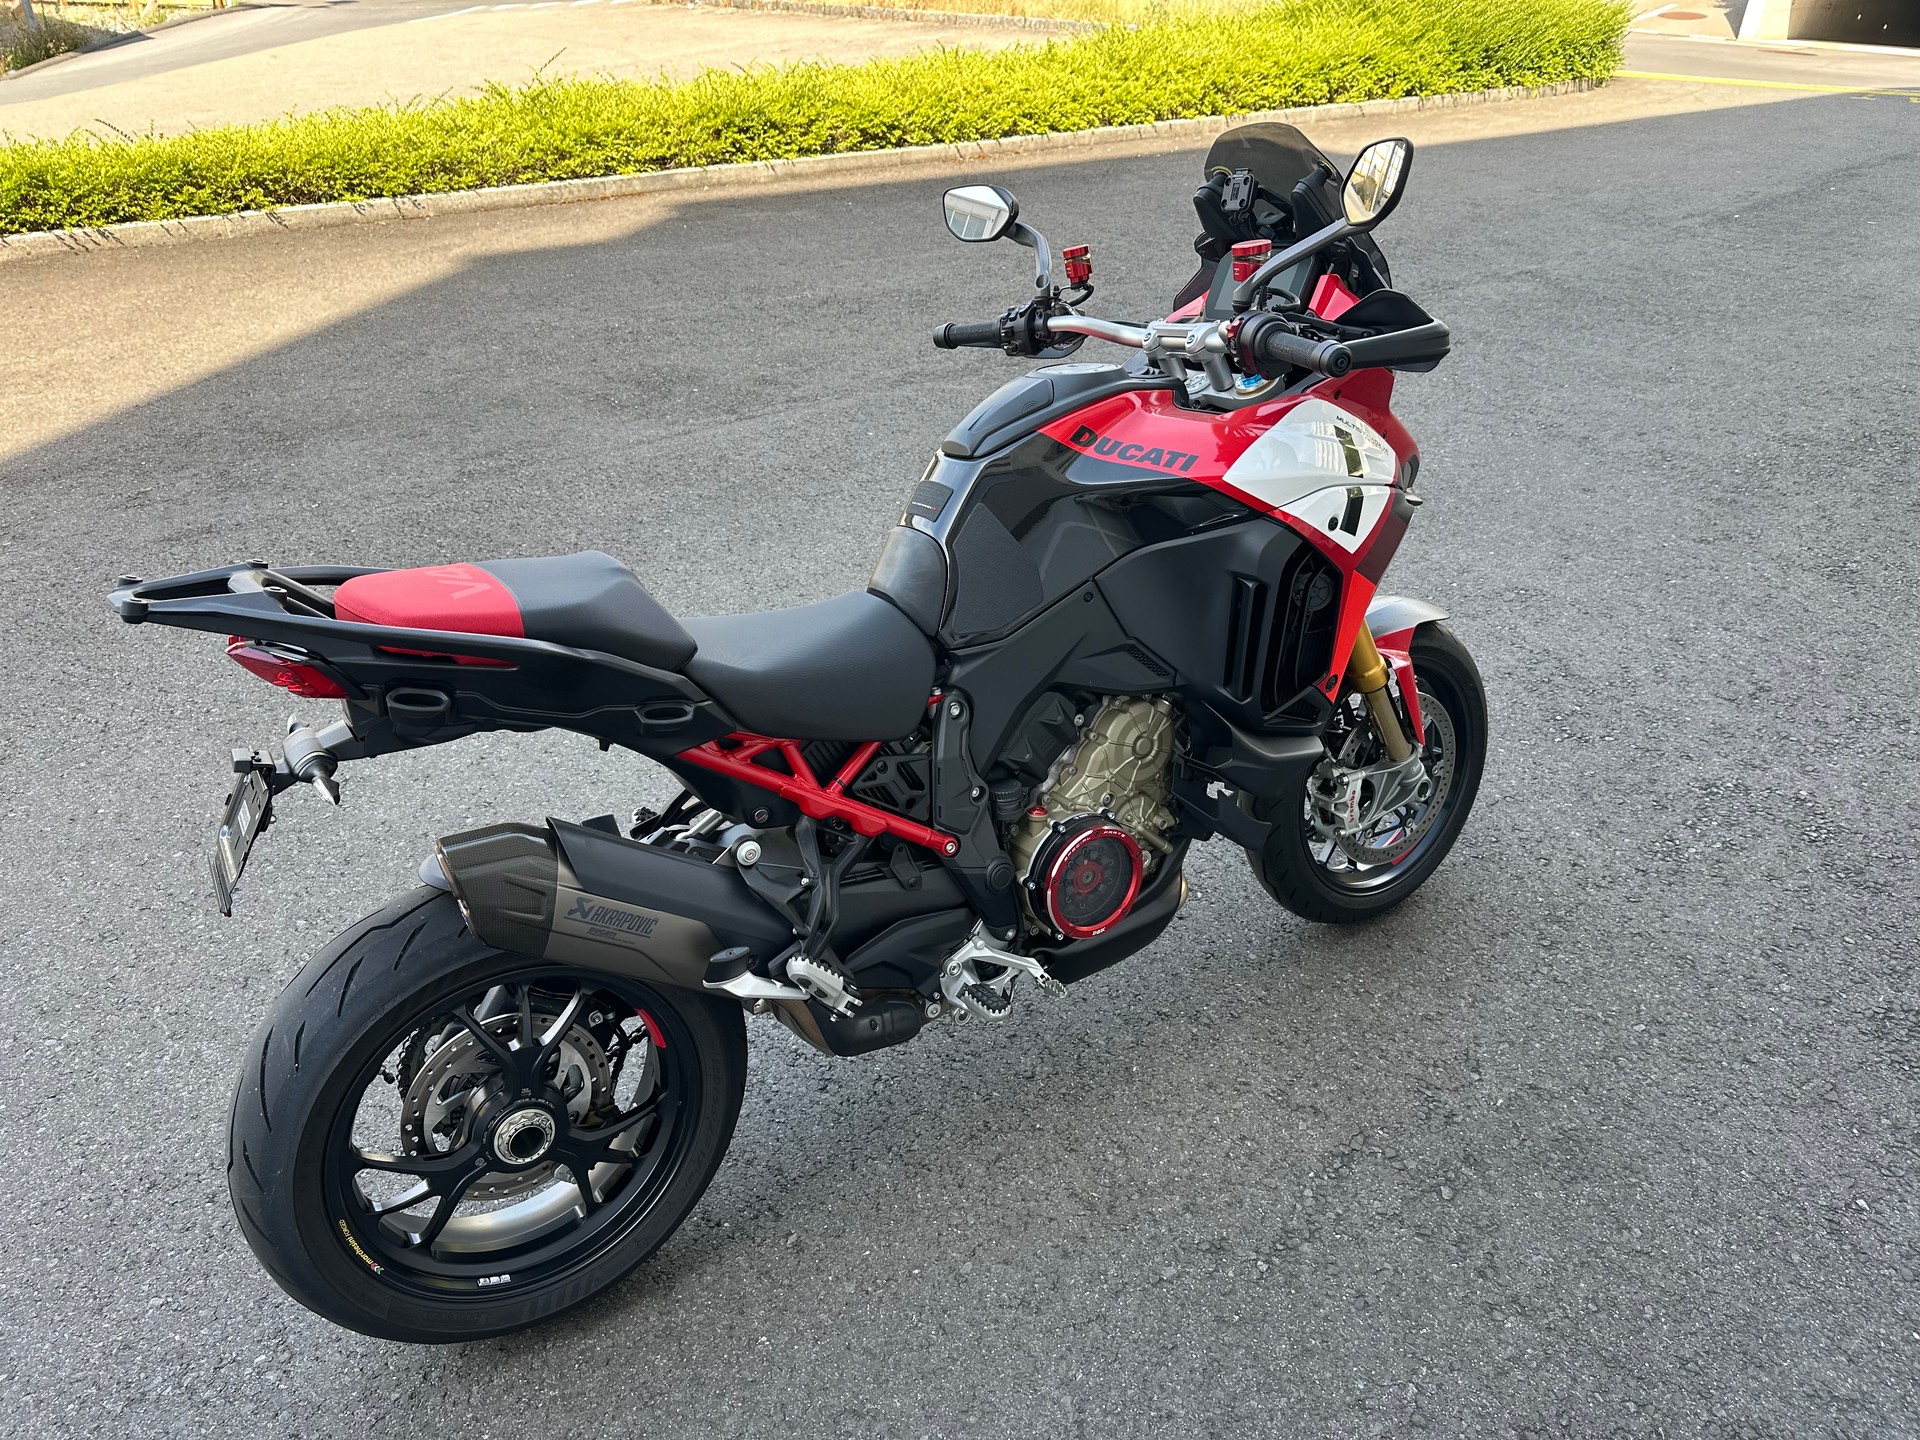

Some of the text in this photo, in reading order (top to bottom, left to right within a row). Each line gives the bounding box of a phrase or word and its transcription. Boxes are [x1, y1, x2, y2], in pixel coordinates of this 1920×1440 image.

[1069, 424, 1199, 472] DUCATI
[1348, 790, 1357, 824] brembo
[1103, 830, 1126, 838] PARTS
[345, 1235, 374, 1265] marchesini
